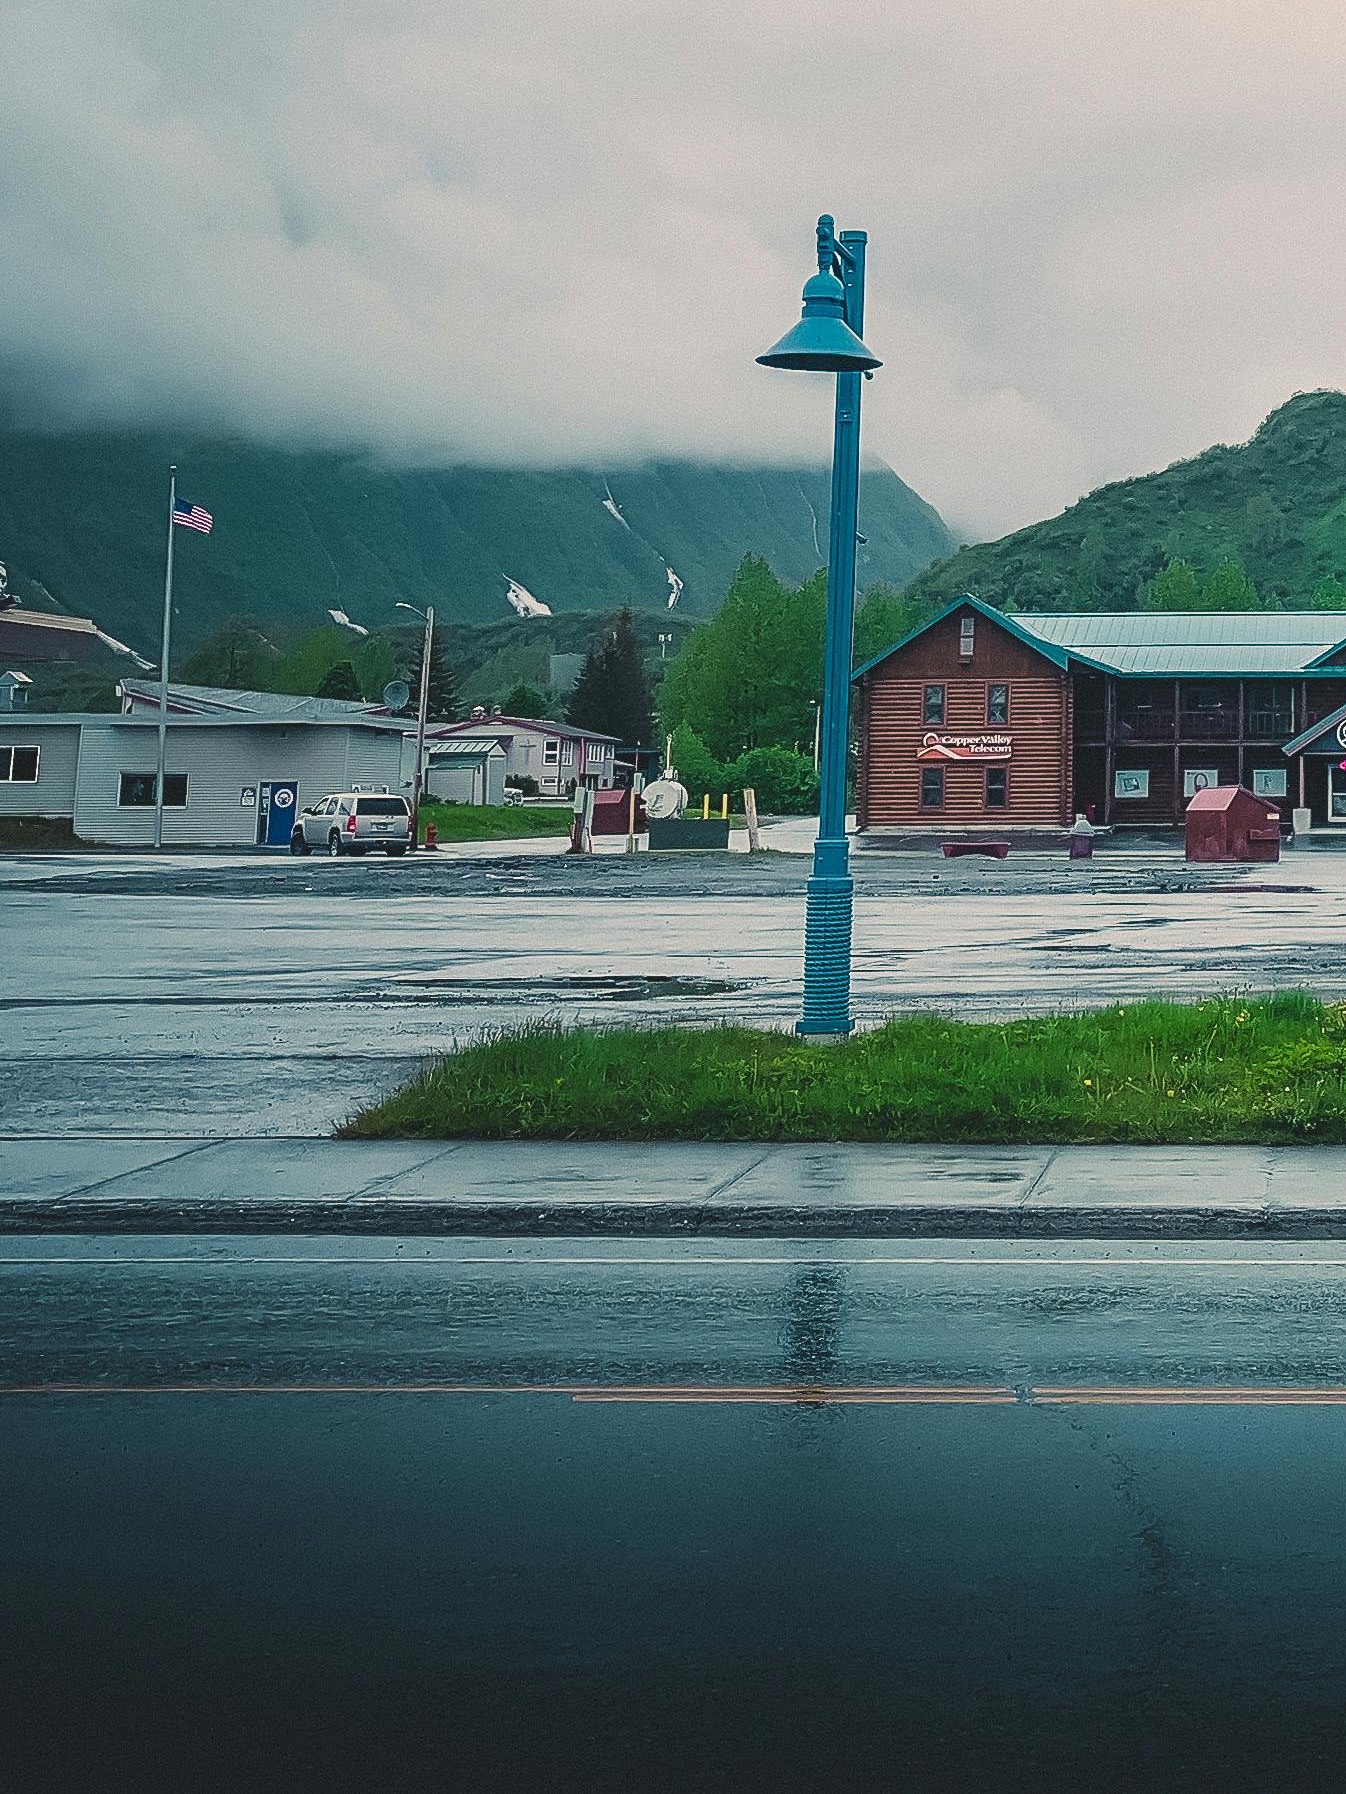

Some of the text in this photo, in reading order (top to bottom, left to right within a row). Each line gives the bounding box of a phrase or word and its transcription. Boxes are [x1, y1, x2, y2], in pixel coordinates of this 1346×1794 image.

[942, 735, 1012, 746] Copper Valley
[969, 745, 1012, 753] Telecom
